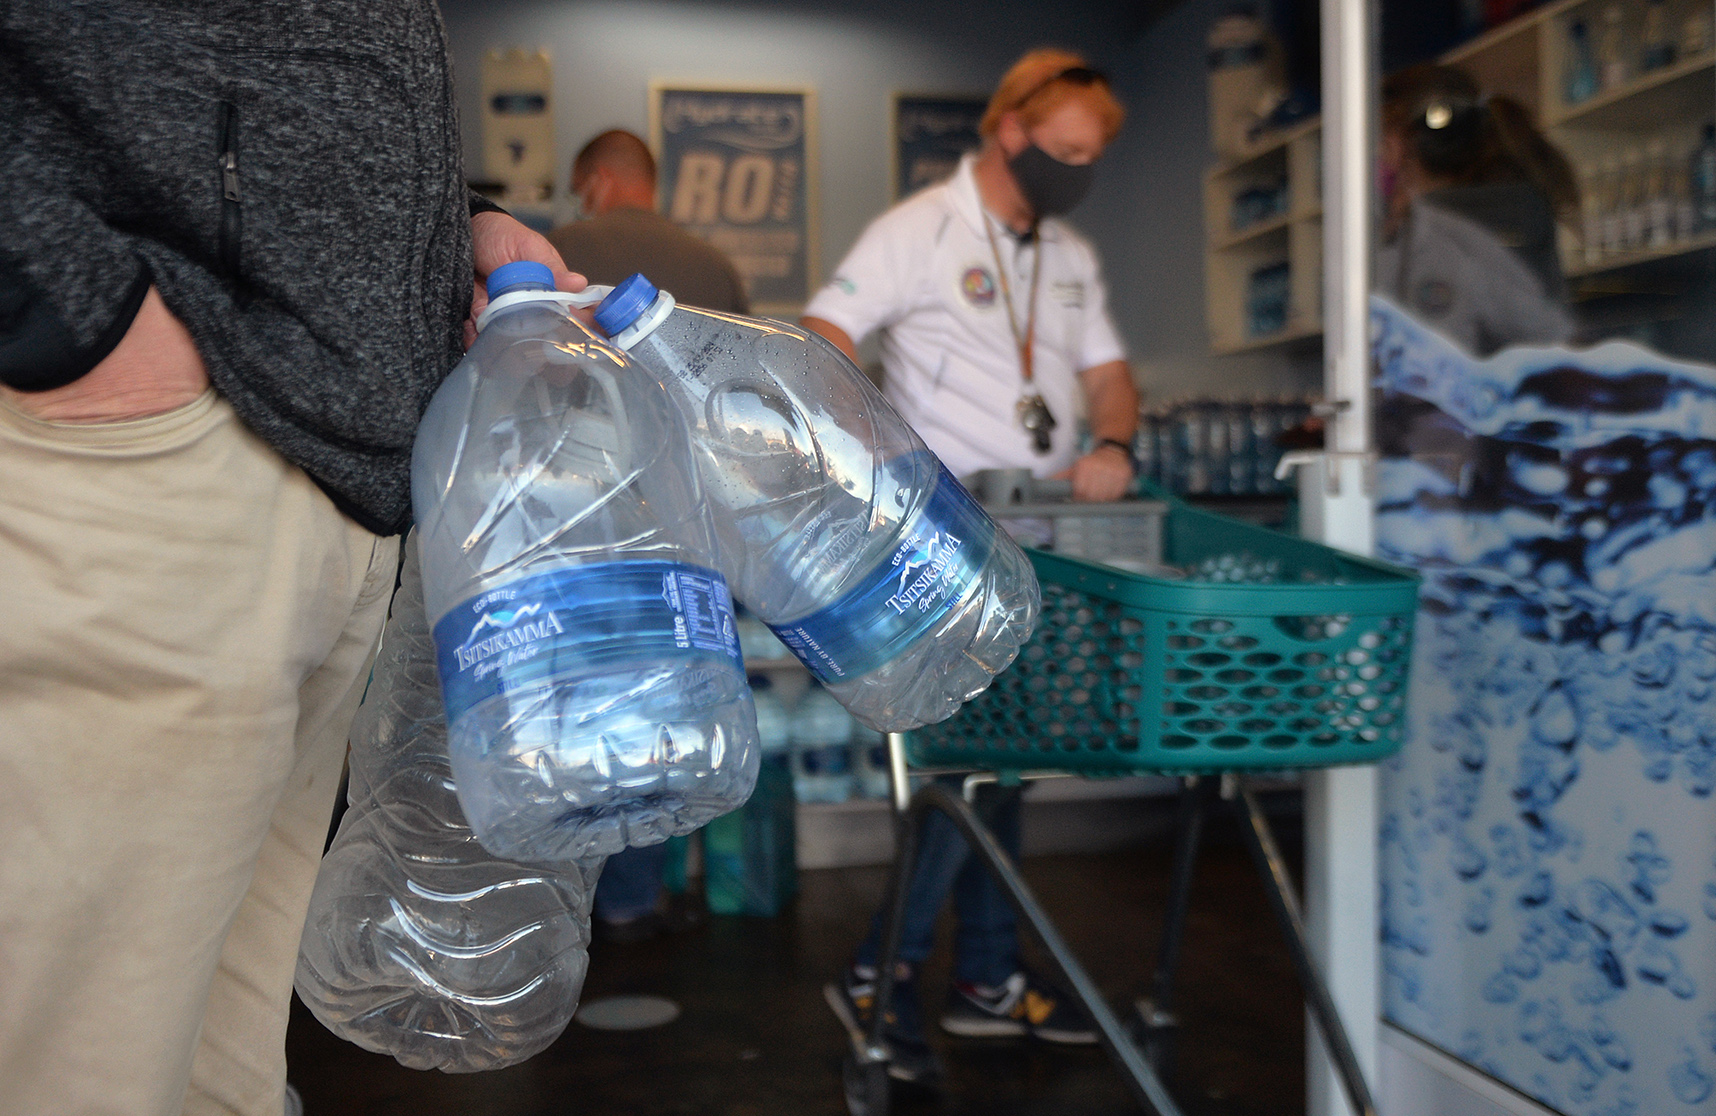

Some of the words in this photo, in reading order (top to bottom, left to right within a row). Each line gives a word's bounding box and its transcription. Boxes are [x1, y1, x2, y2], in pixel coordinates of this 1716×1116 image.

[671, 153, 775, 223] RO
[891, 533, 921, 567] ECO-BOTTLE
[884, 532, 962, 616] TSITSIKAMMA
[918, 585, 946, 613] Spring
[941, 562, 959, 588] Water
[472, 590, 517, 614] ECO-BOTTLE
[945, 592, 963, 611] STILL
[453, 610, 565, 673] TSITSIKAMMA
[674, 614, 688, 640] Litre
[676, 641, 690, 649] 5
